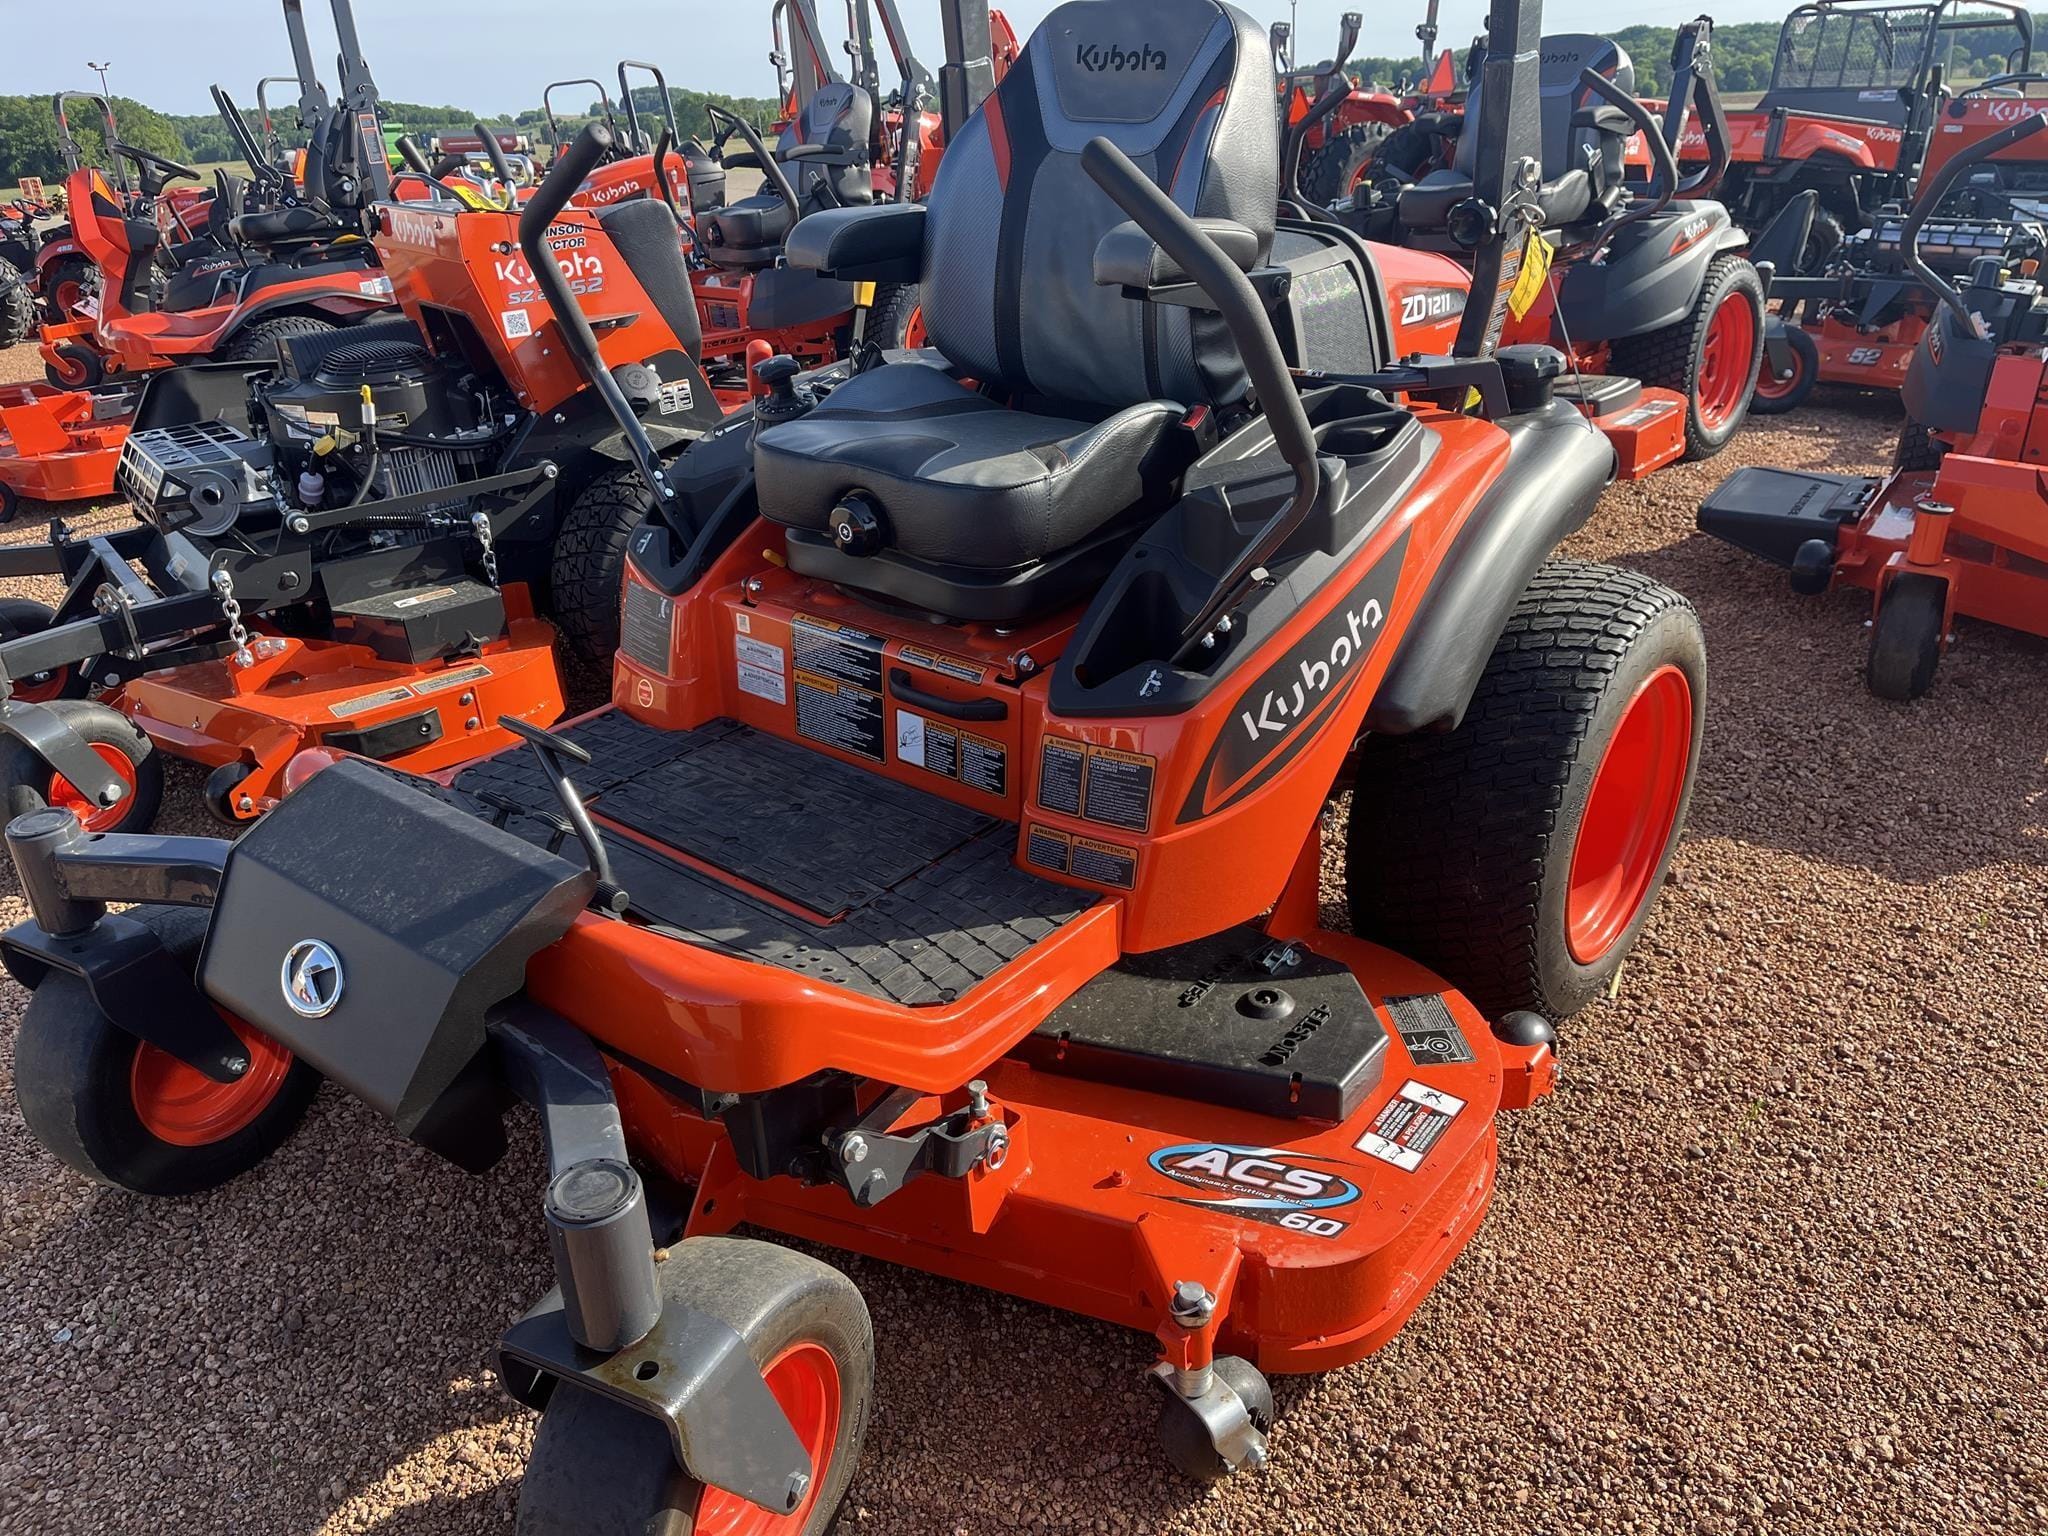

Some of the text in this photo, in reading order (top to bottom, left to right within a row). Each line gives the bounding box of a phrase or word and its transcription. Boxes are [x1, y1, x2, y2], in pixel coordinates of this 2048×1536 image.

[1077, 43, 1166, 72] Kubota
[1540, 52, 1579, 64] ubota
[1866, 127, 1901, 143] Kubota
[592, 181, 640, 202] Kubota
[391, 213, 436, 248] Kubota
[201, 260, 231, 271] Kubota
[495, 252, 603, 285] Kuota
[508, 290, 535, 305] SZ
[1848, 348, 1882, 364] 52
[947, 658, 984, 672] ADVERTENCIA
[1241, 599, 1383, 741] Kubota
[930, 721, 955, 734] WARNING
[966, 734, 1003, 750] ADVERTENCIA
[1055, 739, 1080, 750] WARNING
[1104, 750, 1146, 764] ADVERTENCIA
[1038, 828, 1066, 840] WARNING
[1084, 840, 1130, 856] ADVERTENCIA
[1378, 1099, 1400, 1123] DANGER
[1406, 1111, 1428, 1136] PELIGRO
[1175, 1150, 1332, 1196] ACS
[1166, 1169, 1314, 1207] Aerodynamic Cutting System
[1280, 1213, 1343, 1235] 60
